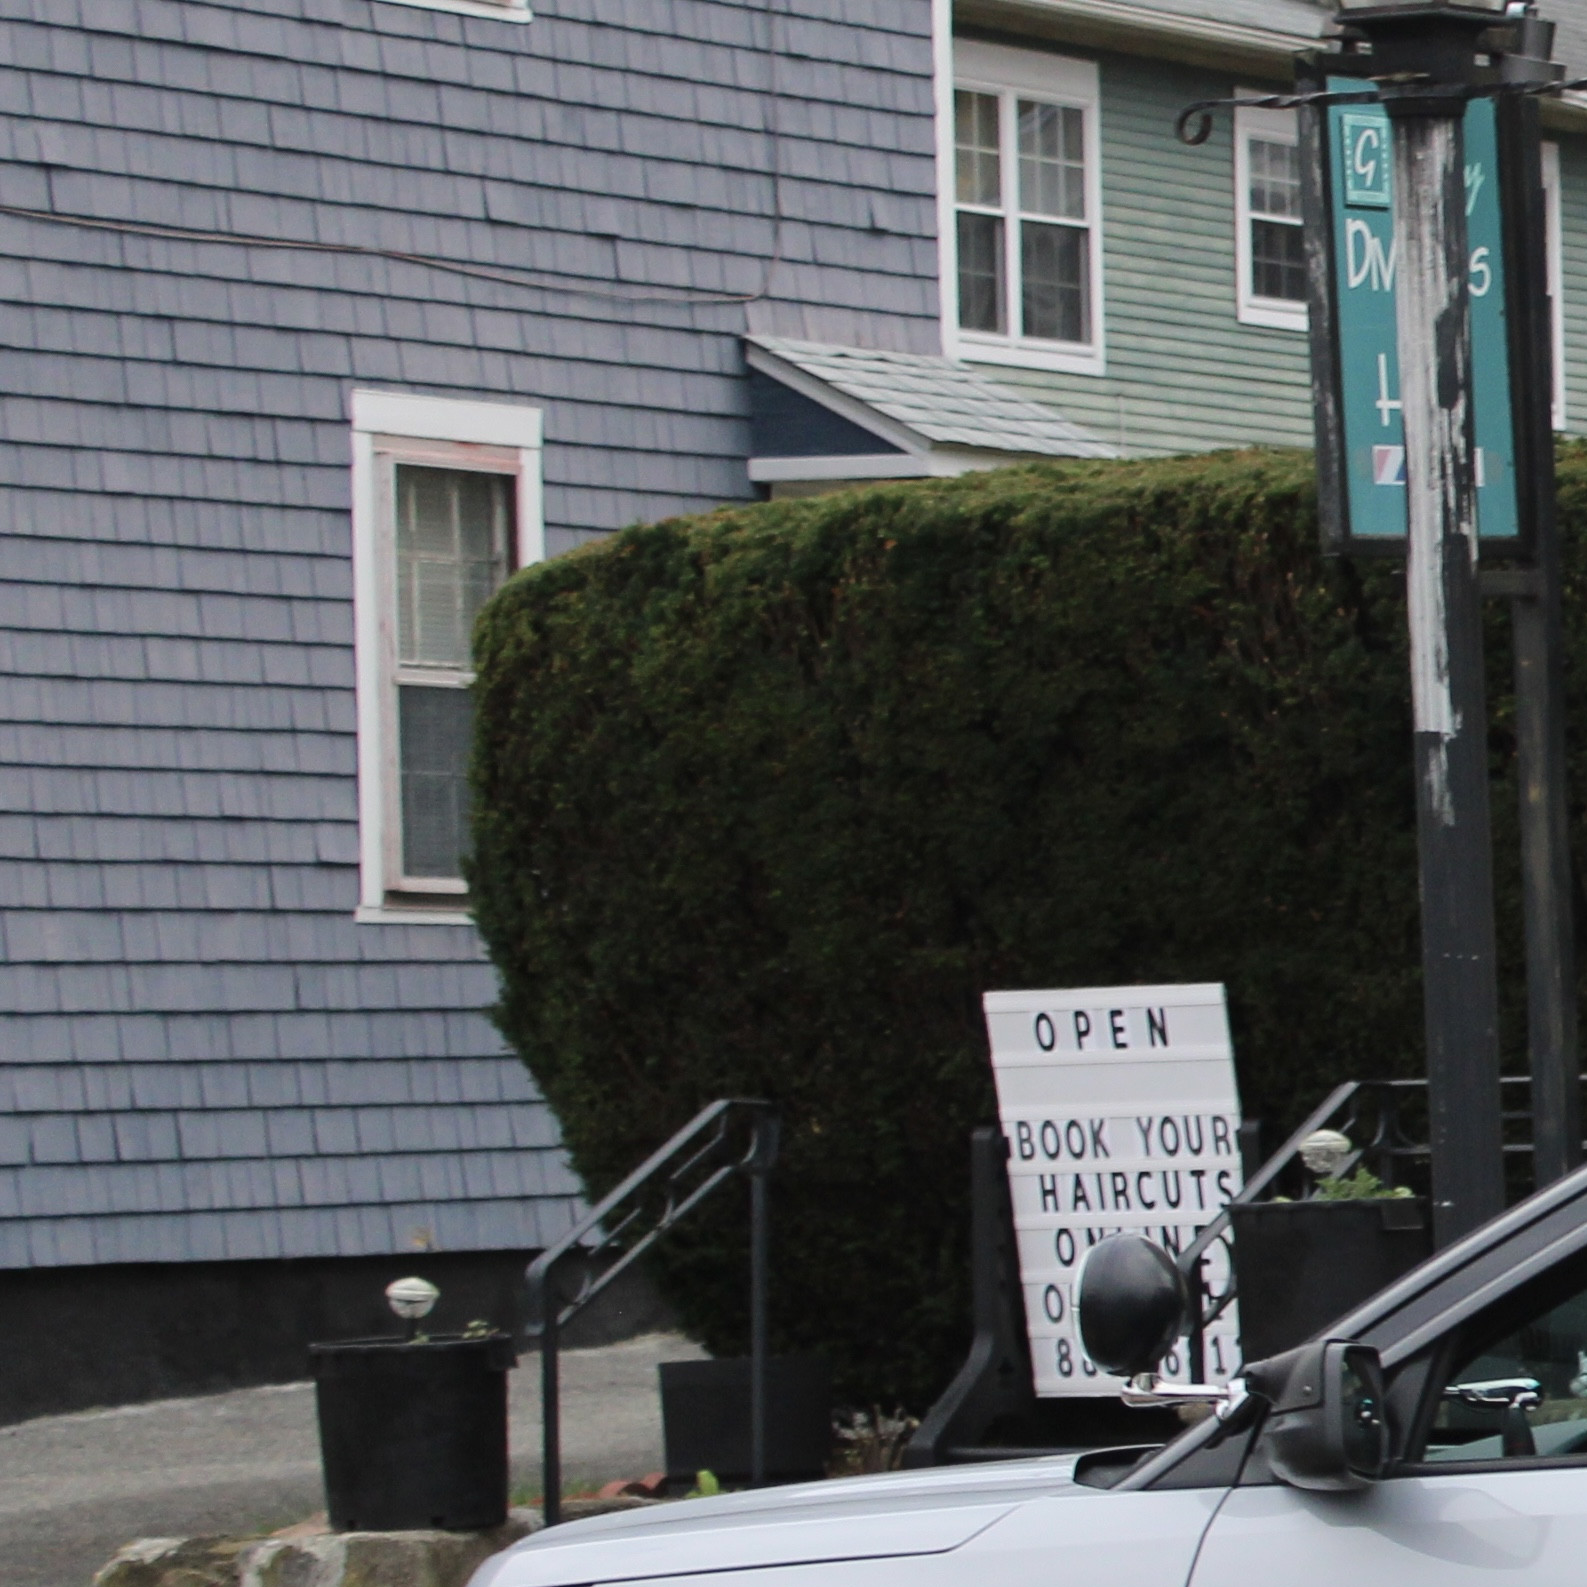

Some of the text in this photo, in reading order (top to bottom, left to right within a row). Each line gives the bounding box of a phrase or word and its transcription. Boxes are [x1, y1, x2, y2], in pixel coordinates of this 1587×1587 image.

[1035, 1007, 1169, 1052] OPEN
[1015, 1115, 1232, 1161] BOOK YOUR
[1040, 1170, 1234, 1213] HAIRCUTS
